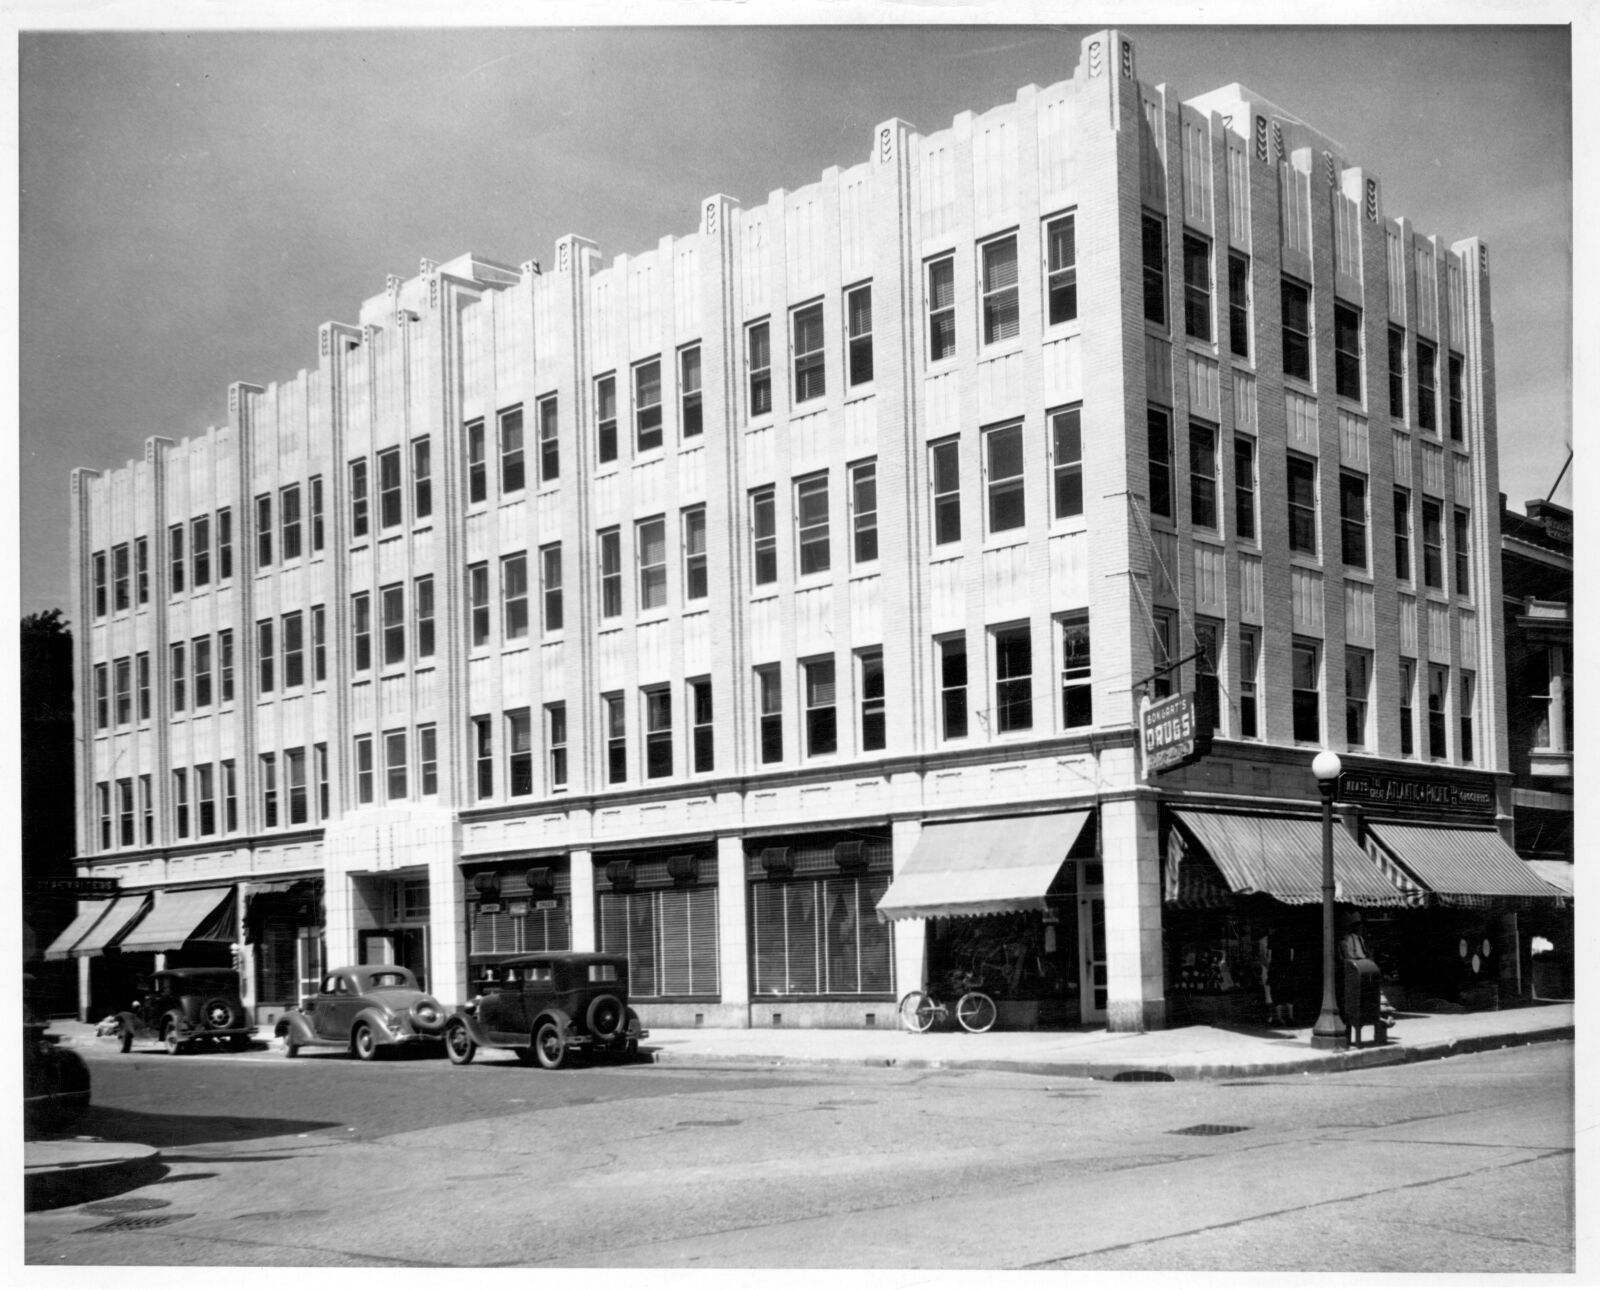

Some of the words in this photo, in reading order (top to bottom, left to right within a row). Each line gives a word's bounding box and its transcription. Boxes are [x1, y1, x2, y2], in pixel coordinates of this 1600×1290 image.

[1146, 713, 1190, 751] DRUGS
[1386, 779, 1420, 801] ATLANTIC
[1426, 783, 1449, 803] PACIFIC
